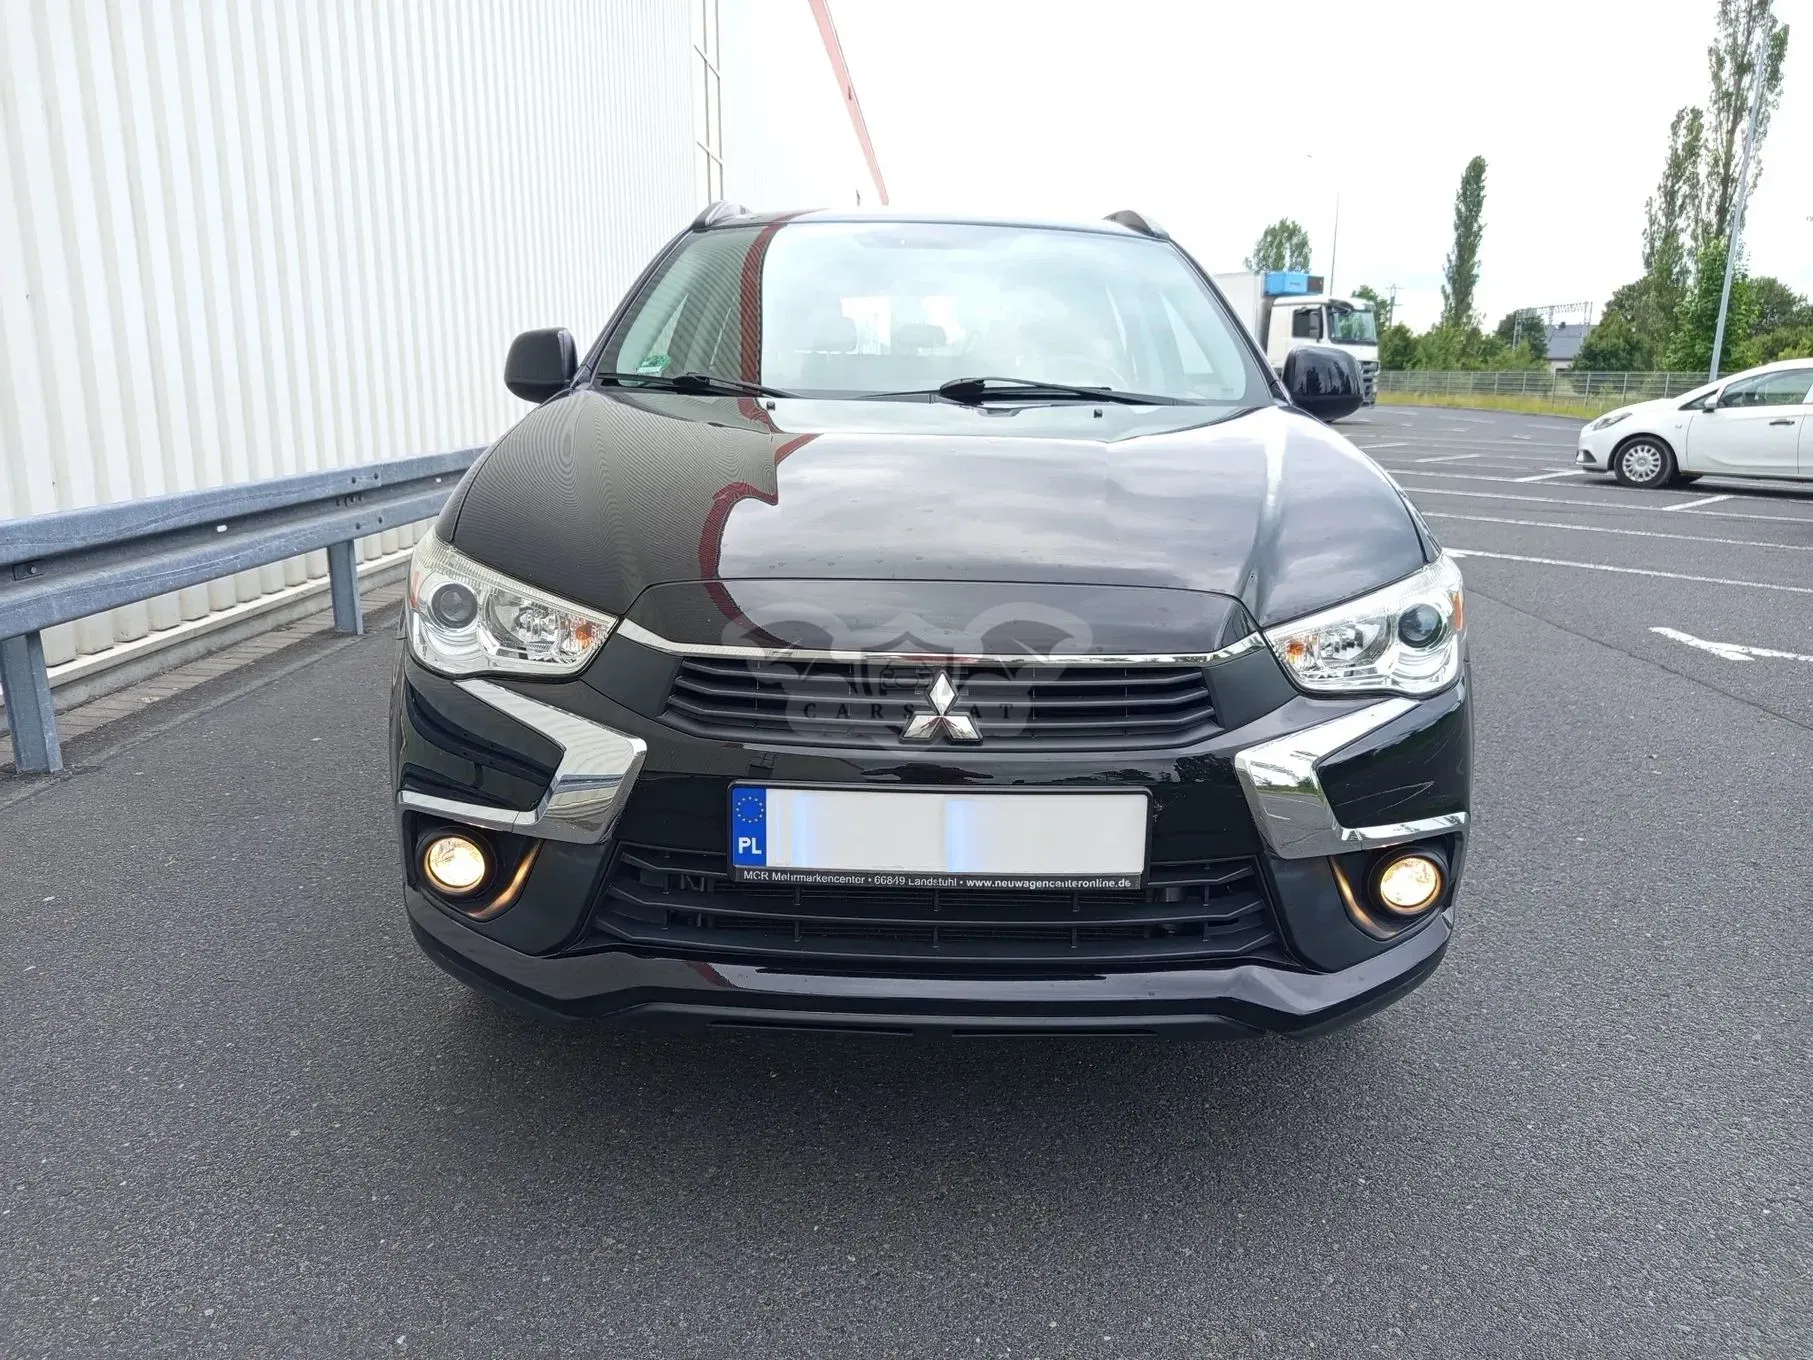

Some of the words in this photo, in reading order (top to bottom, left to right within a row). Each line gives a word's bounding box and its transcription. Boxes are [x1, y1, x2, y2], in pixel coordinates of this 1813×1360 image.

[738, 837, 762, 854] PL
[743, 870, 769, 880] MCR
[874, 876, 906, 885] 66849
[908, 877, 957, 886] Landstuhl
[966, 879, 1131, 890] www.neuwagencenteronline.de
